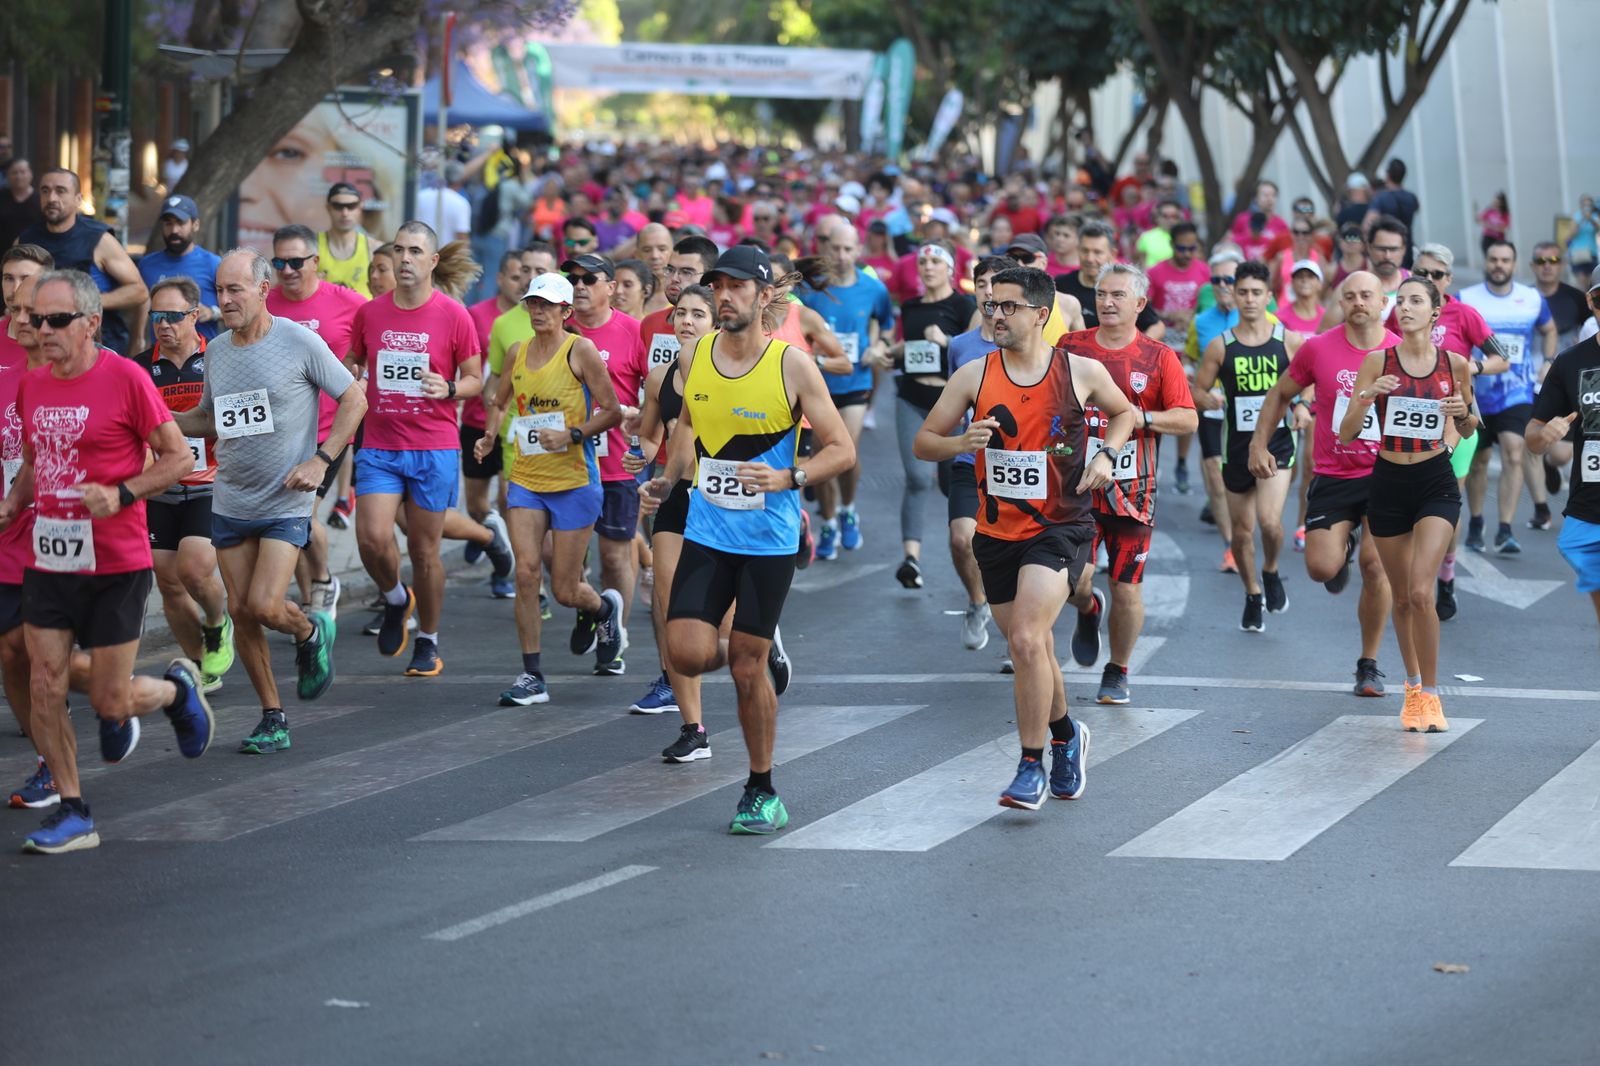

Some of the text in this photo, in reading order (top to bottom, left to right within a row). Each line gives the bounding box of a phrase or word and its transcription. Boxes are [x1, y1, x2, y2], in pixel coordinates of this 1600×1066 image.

[908, 351, 935, 365] 305
[1234, 354, 1278, 375] RUN
[383, 365, 423, 381] 526
[1236, 372, 1278, 392] RUN
[529, 393, 560, 408] Álora
[222, 405, 267, 428] 313
[1393, 410, 1439, 430] 299
[993, 465, 1040, 486] 536
[39, 536, 84, 557] 607
